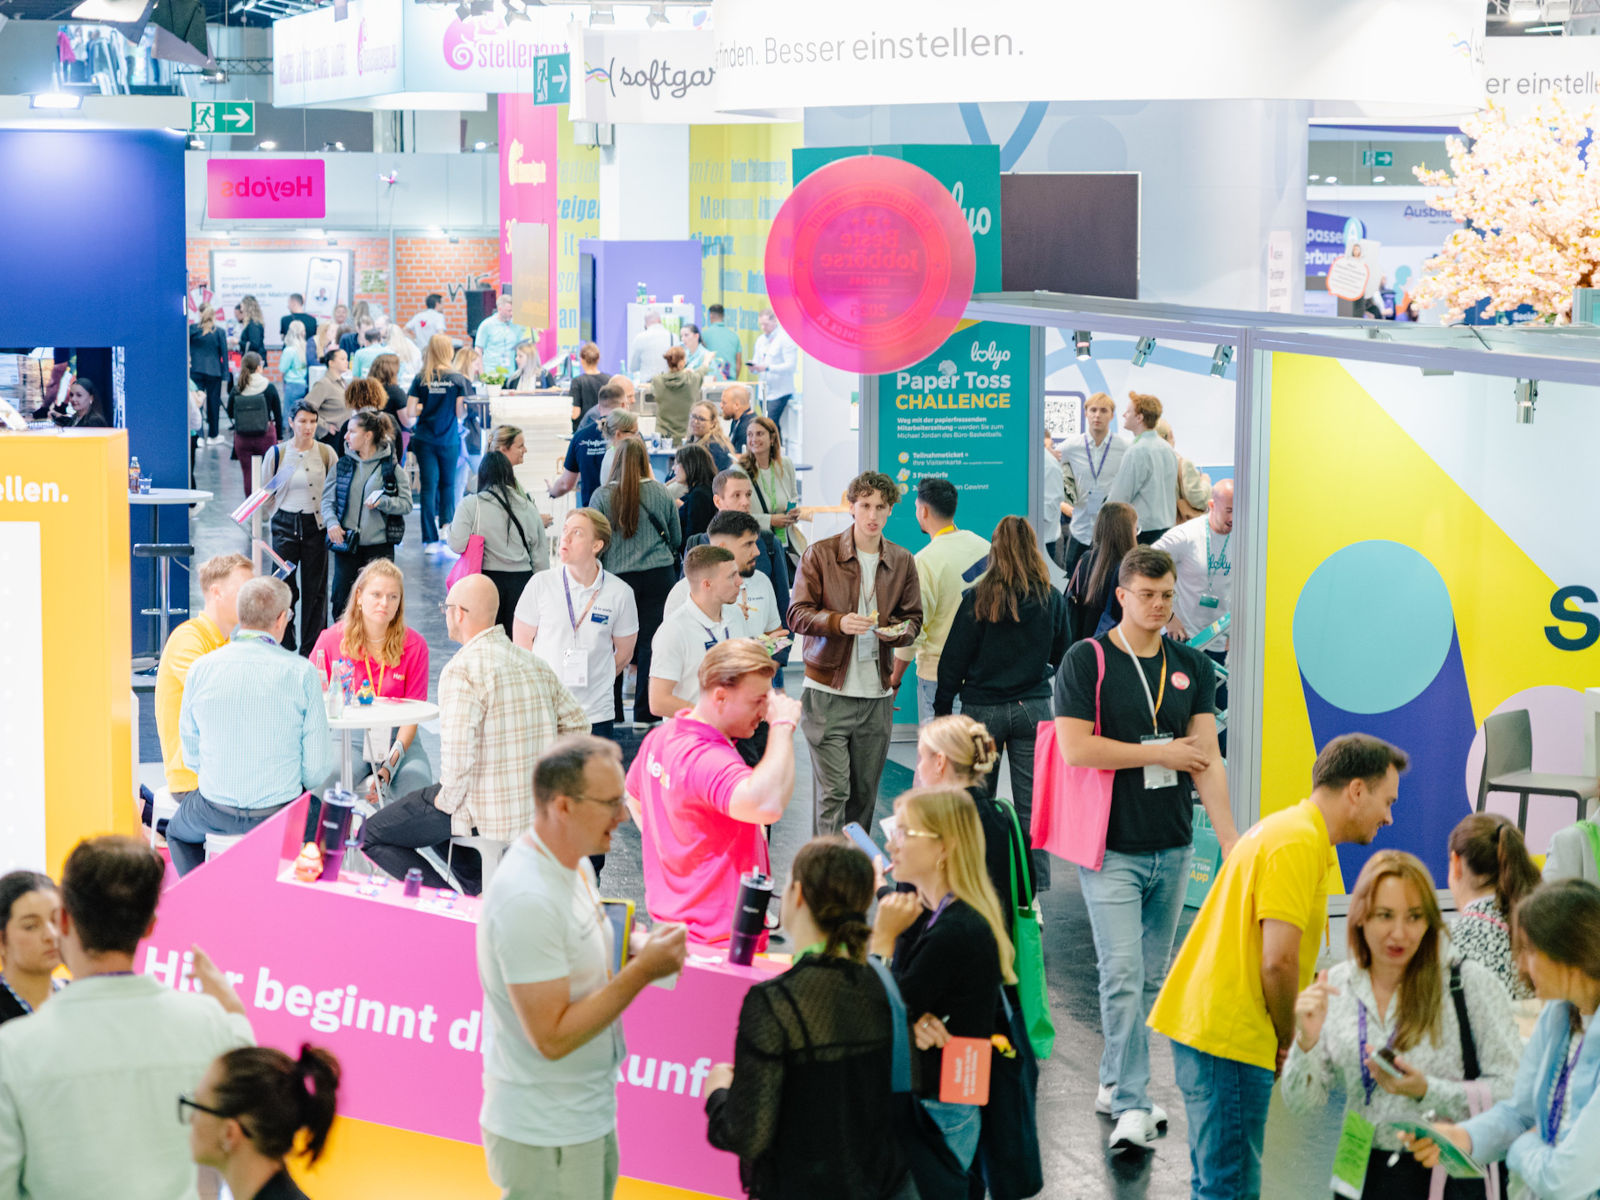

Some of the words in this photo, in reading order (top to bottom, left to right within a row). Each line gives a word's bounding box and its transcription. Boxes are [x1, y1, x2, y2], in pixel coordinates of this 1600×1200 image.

[765, 36, 845, 64] Besser
[852, 27, 1024, 60] einstellen.
[896, 372, 960, 394] Paper
[963, 371, 1012, 390] Toss
[895, 393, 1012, 410] CHALLENGE
[0, 475, 69, 503] llen.
[1190, 869, 1209, 883] App
[253, 966, 438, 1044] beginnt
[448, 1010, 485, 1054] d
[617, 1054, 713, 1099] unf
